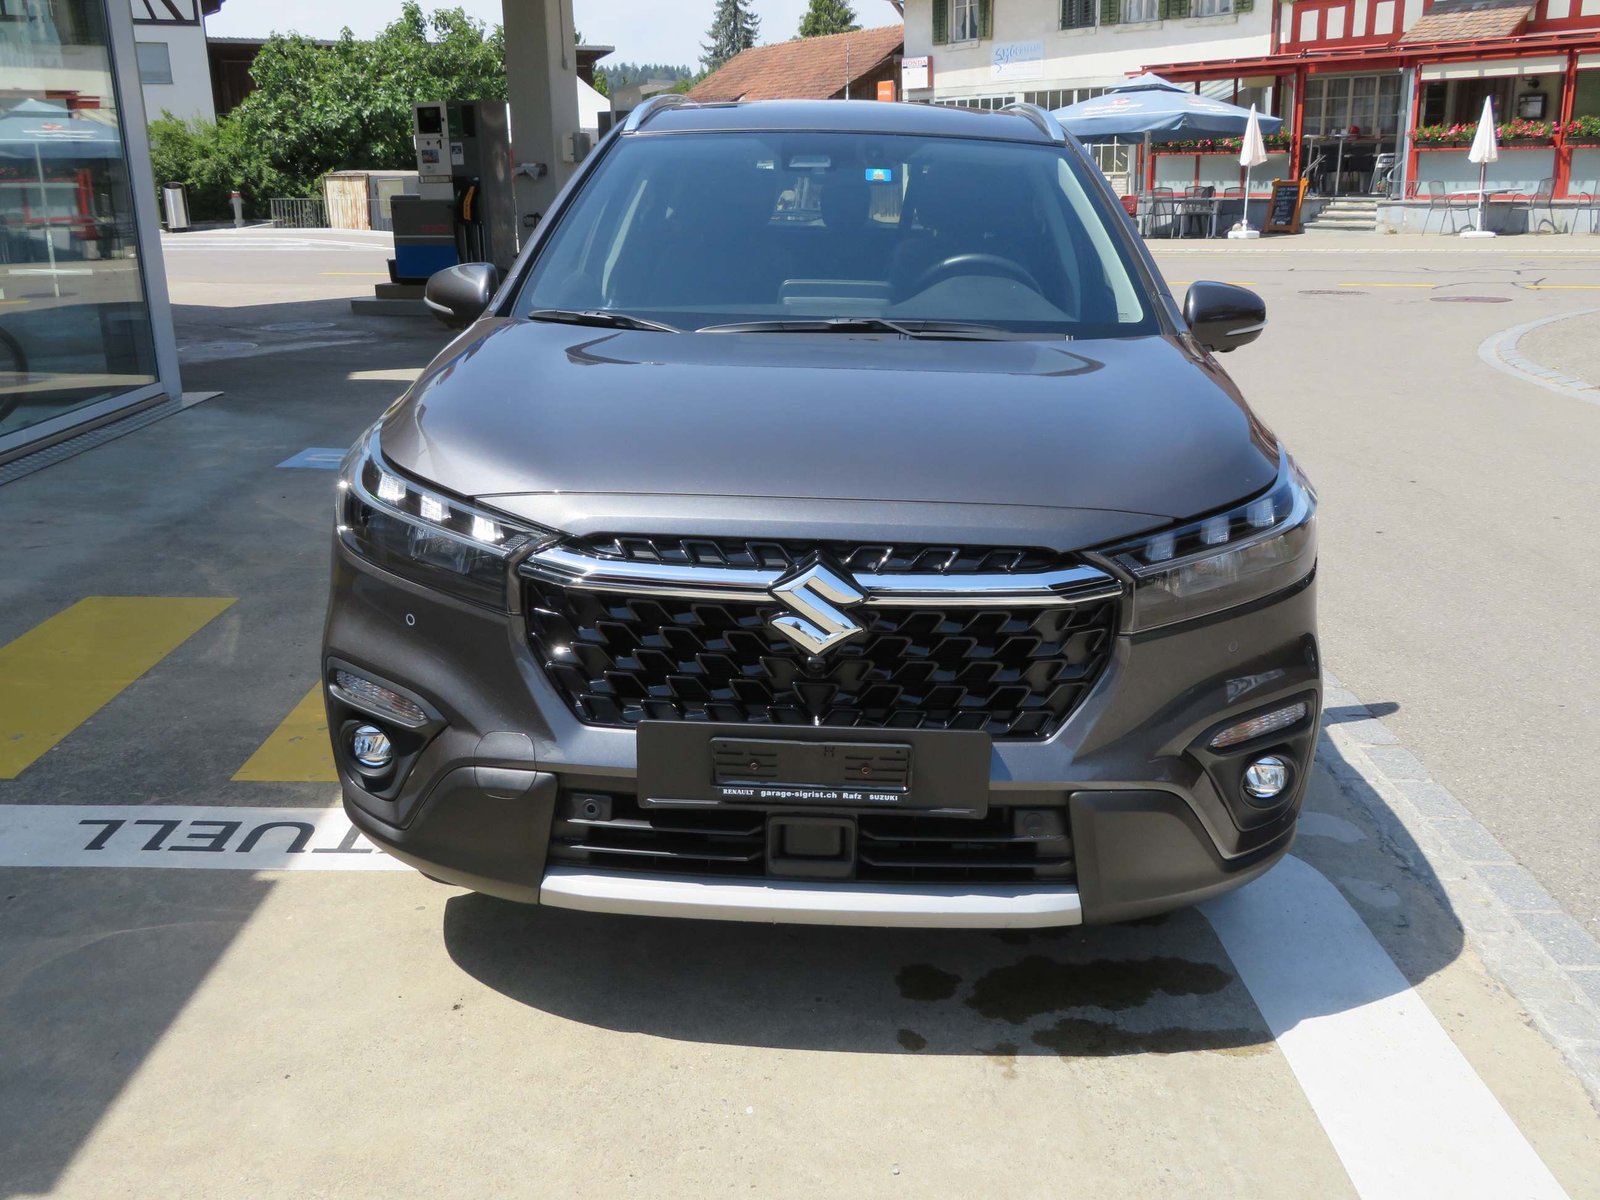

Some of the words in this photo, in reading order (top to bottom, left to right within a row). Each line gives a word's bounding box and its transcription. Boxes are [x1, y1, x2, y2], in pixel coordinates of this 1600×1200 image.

[436, 139, 443, 150] 1
[723, 788, 754, 796] RENAULT
[760, 789, 837, 799] garage-sigrist.ch
[842, 792, 862, 800] Rafz
[78, 819, 388, 854] TUELL
